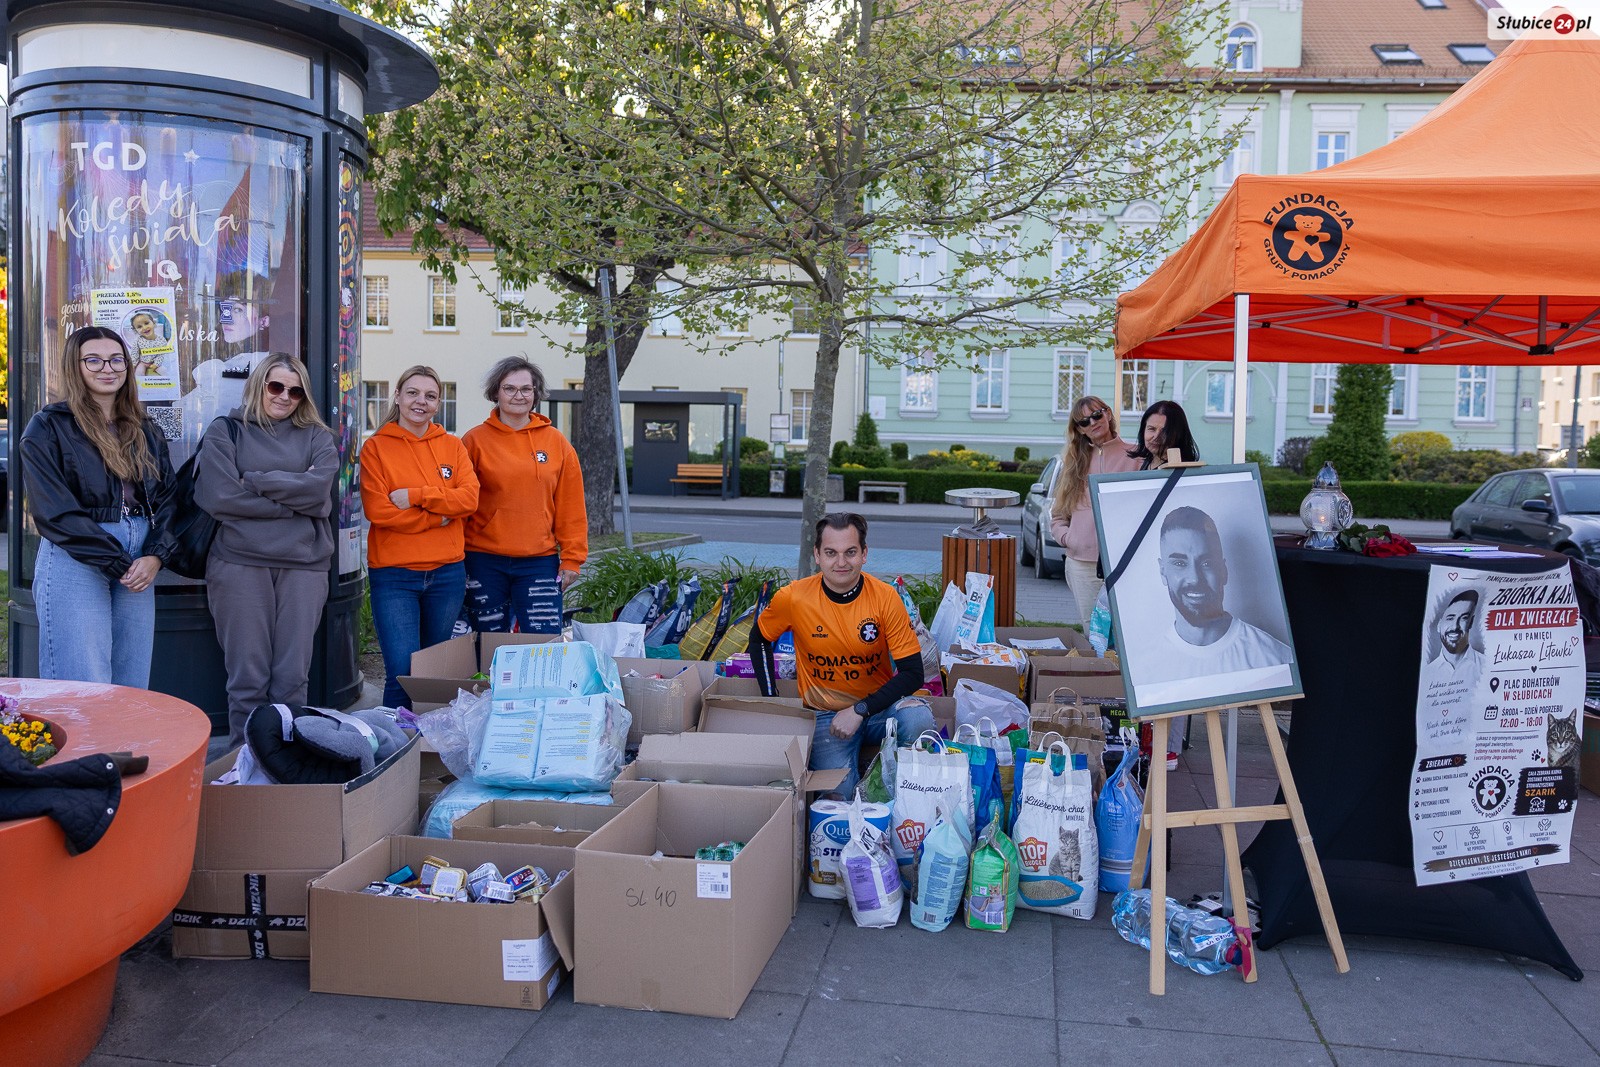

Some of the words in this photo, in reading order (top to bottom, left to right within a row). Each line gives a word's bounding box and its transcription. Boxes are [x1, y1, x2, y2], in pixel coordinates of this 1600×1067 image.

[71, 142, 147, 171] TGD
[58, 179, 193, 243] Kolędy
[1263, 193, 1355, 230] FUNDACJA
[107, 201, 241, 270] świata
[1263, 238, 1290, 275] GRUPY
[1291, 243, 1351, 281] POMAGAMY
[1488, 583, 1549, 606] ZBIÓRKA
[1494, 612, 1515, 627] DLA
[1519, 610, 1574, 626] ZWIERZĄT
[1525, 632, 1552, 641] PAMIĘCI
[808, 651, 882, 667] POMAGAMY
[1493, 644, 1536, 665] Łukasza
[1538, 641, 1573, 662] Litewki
[812, 668, 836, 681] JUŻ
[844, 670, 860, 681] 10
[1503, 679, 1520, 690] PLAC
[1522, 675, 1560, 688] BOHATERÓW
[1503, 691, 1510, 701] W
[1512, 689, 1552, 701] SŁUBICACH
[1501, 706, 1518, 716] ŚRODA
[1524, 705, 1537, 715] DZIEŃ
[1500, 718, 1519, 728] 12:00
[1526, 716, 1543, 727] 18:00
[1425, 758, 1452, 768] ZBIERAMY:
[1468, 765, 1515, 789] FUNDACJA
[1525, 788, 1556, 797] SZARIK
[1067, 804, 1085, 813] chat
[1485, 795, 1512, 818] POMAGAMY
[898, 825, 924, 842] TOP
[1020, 844, 1047, 860] TOP
[1449, 859, 1483, 868] DZIĘKUJEMY,
[174, 913, 202, 924] DZIK
[1072, 908, 1082, 917] 10L
